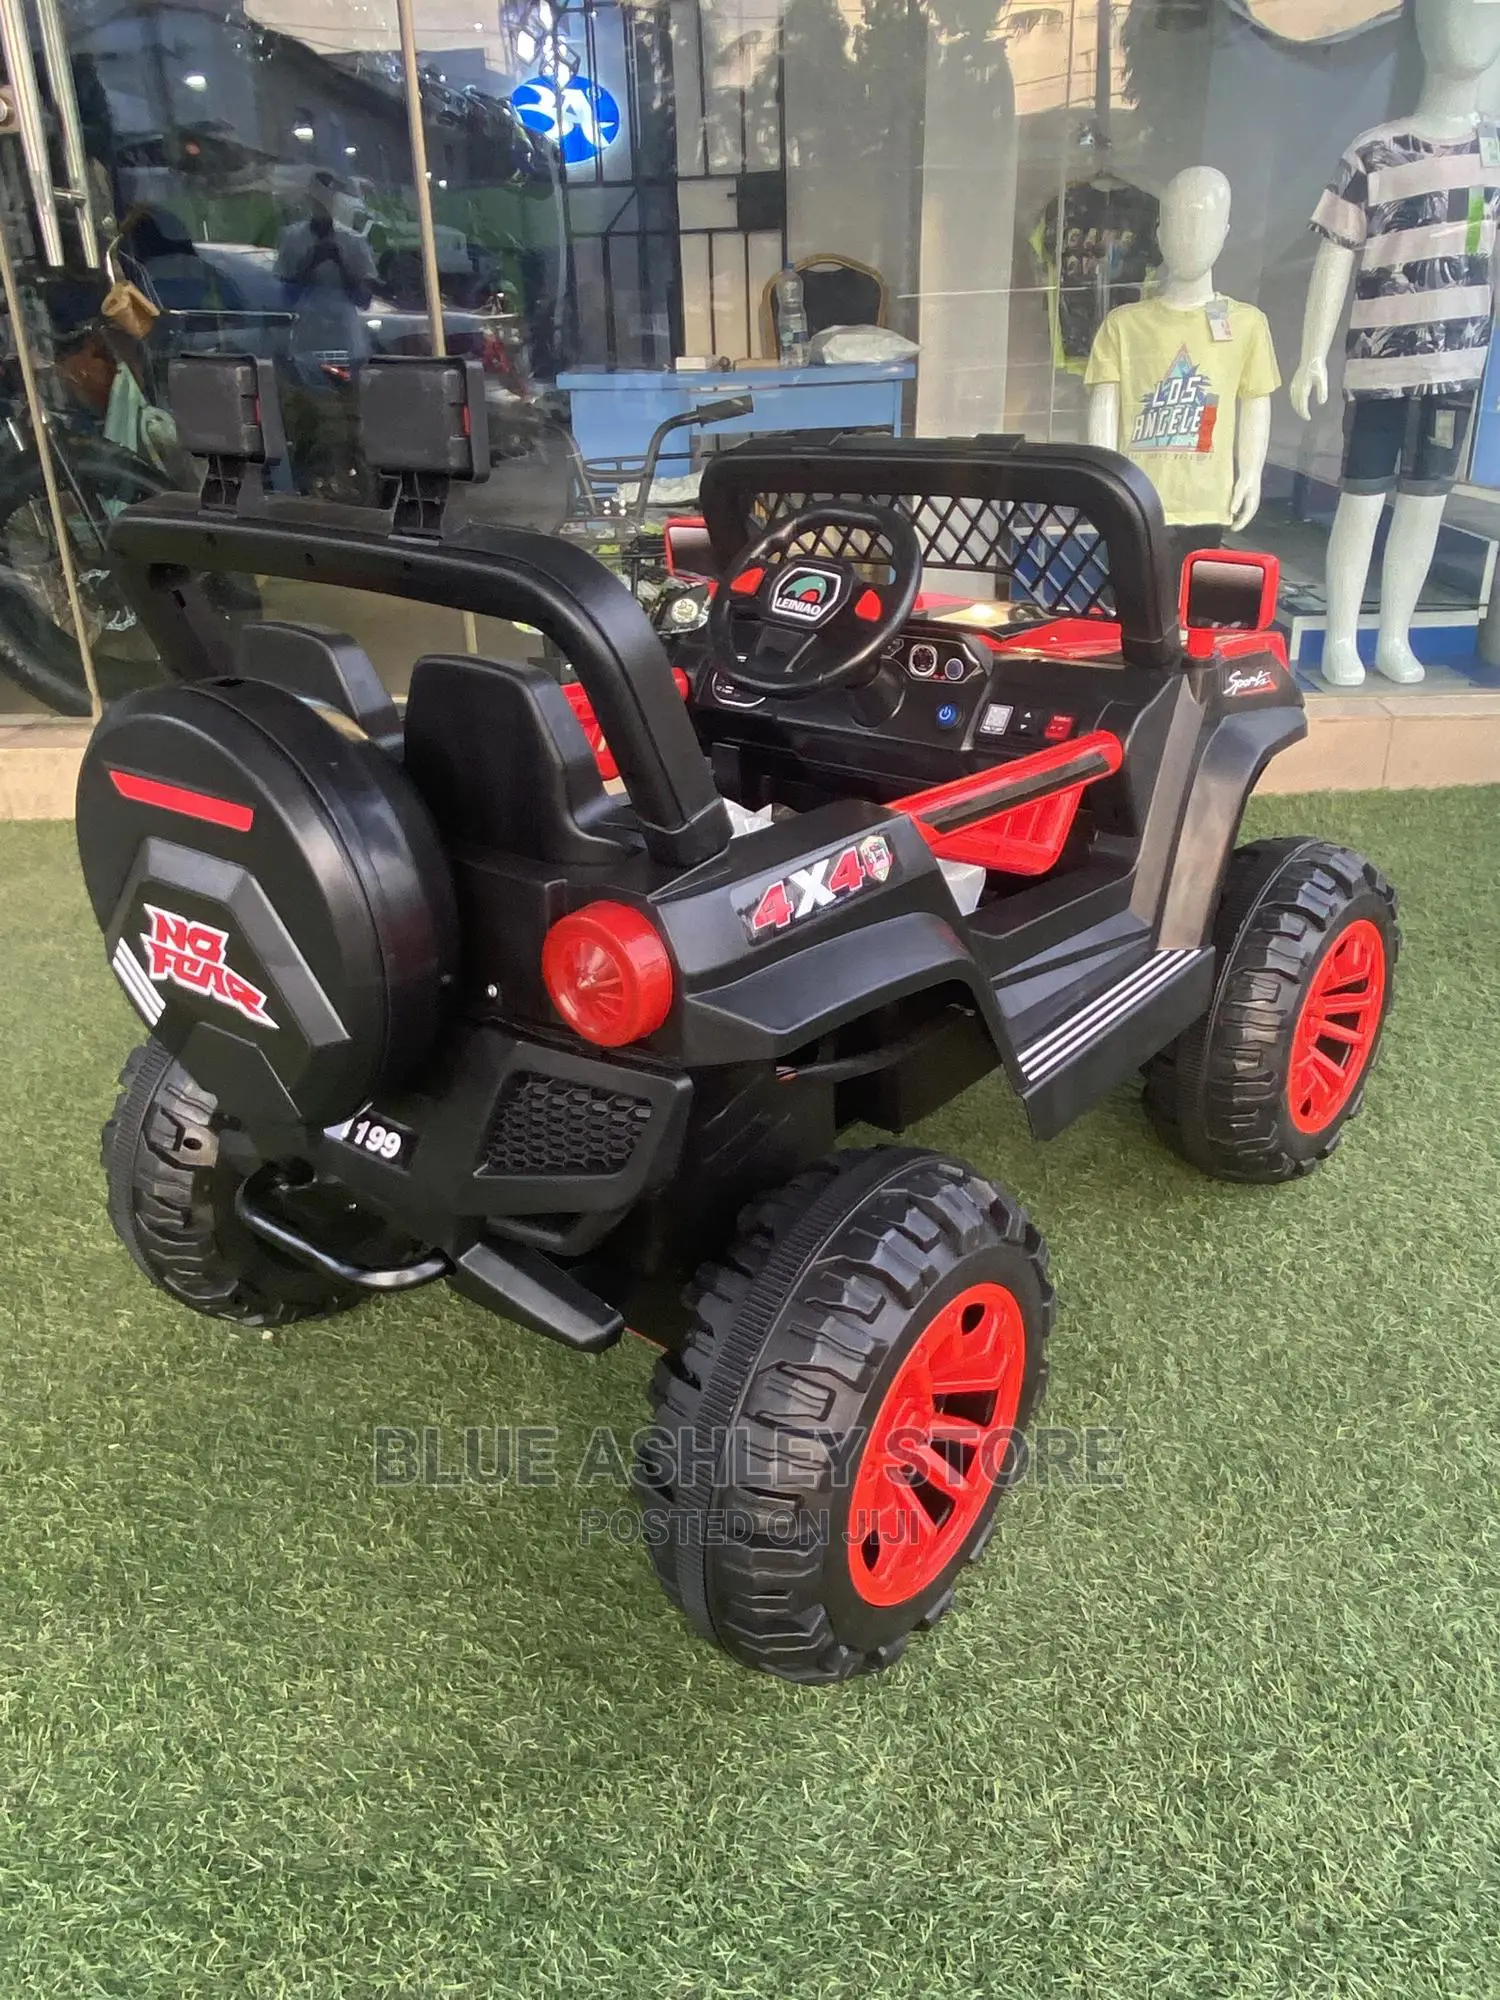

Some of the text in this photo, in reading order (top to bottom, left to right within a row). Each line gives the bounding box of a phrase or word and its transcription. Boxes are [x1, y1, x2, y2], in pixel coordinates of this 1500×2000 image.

[1152, 375, 1202, 408] LOS
[1131, 405, 1209, 442] ANGELE
[775, 597, 822, 615] LEINIAO
[752, 846, 865, 930] 4X4
[143, 903, 230, 965] NO
[140, 933, 280, 1030] FEAR
